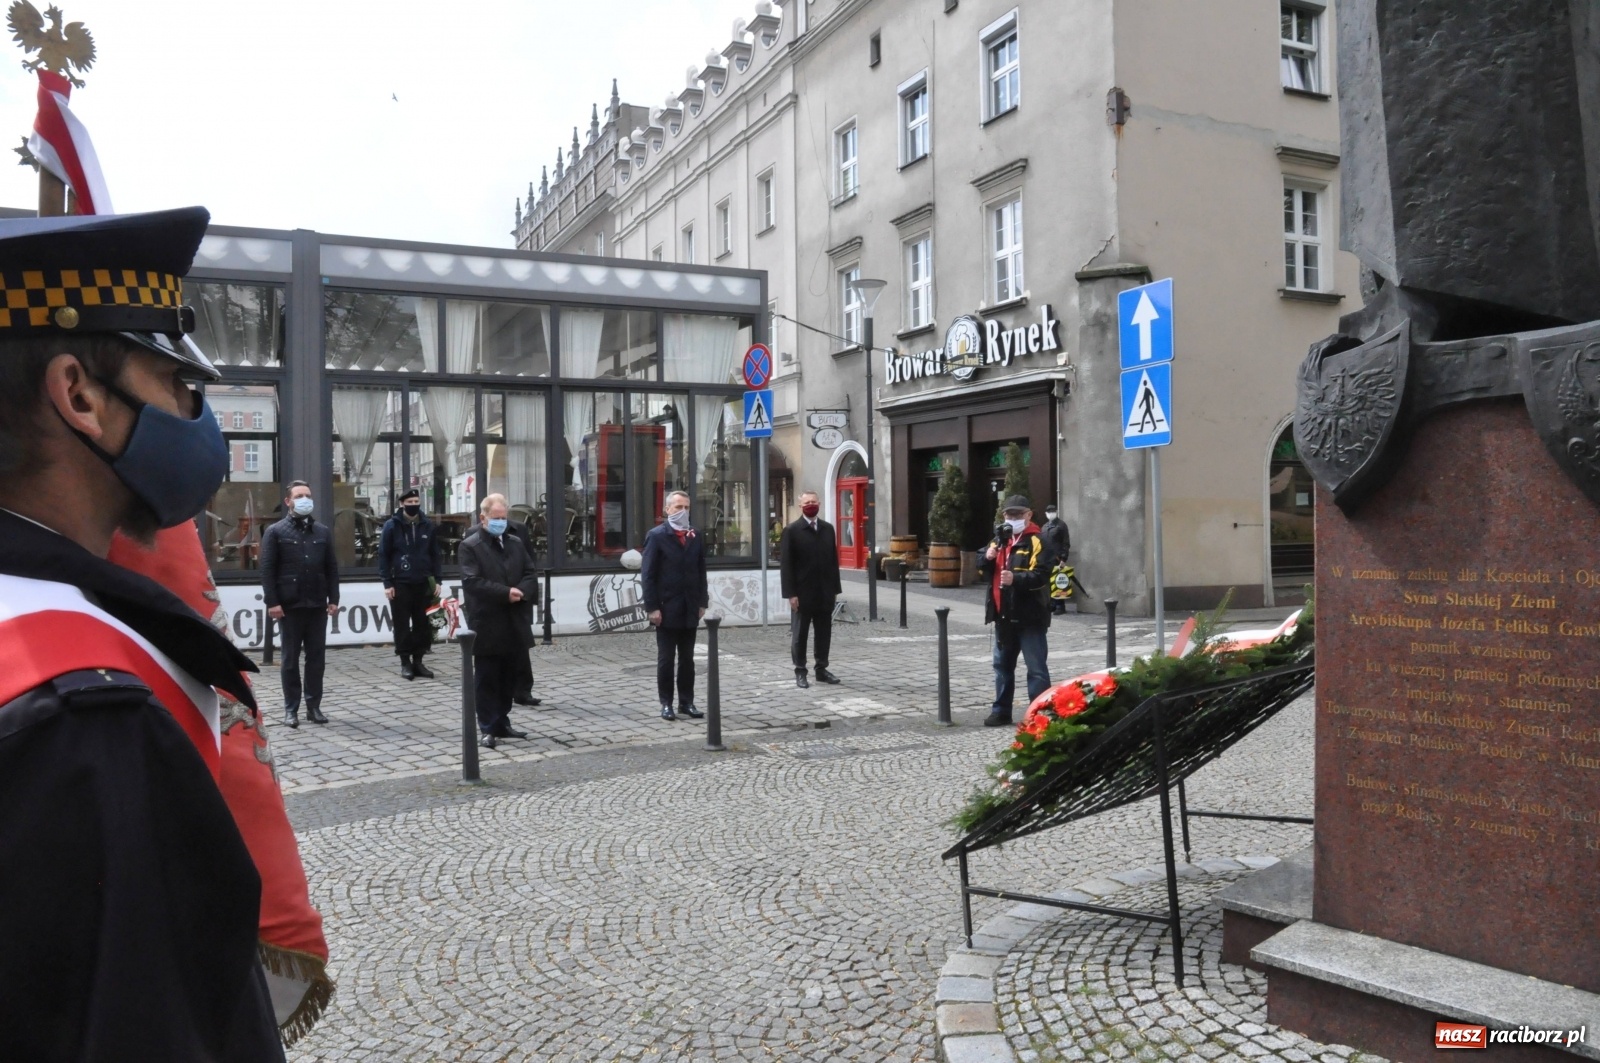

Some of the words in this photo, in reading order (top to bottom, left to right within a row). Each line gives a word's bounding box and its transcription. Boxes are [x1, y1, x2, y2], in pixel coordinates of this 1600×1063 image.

[884, 347, 943, 385] Browar
[986, 304, 1058, 367] Rynek
[818, 416, 840, 425] BUTIK
[1331, 565, 1345, 578] W
[1457, 568, 1478, 582] dla
[1560, 569, 1565, 584] i
[1403, 591, 1438, 608] Syna
[1510, 593, 1556, 609] Ziemi
[597, 612, 634, 631] Browar
[1494, 618, 1549, 635] Feliksa
[1410, 641, 1461, 655] pomnik
[1469, 643, 1552, 661] wzniesiono
[1365, 659, 1381, 672] ku
[1485, 692, 1489, 706] i
[1498, 696, 1572, 714] staraniem
[1324, 700, 1407, 721] Towarzystwa
[1506, 719, 1551, 738] Ziemi
